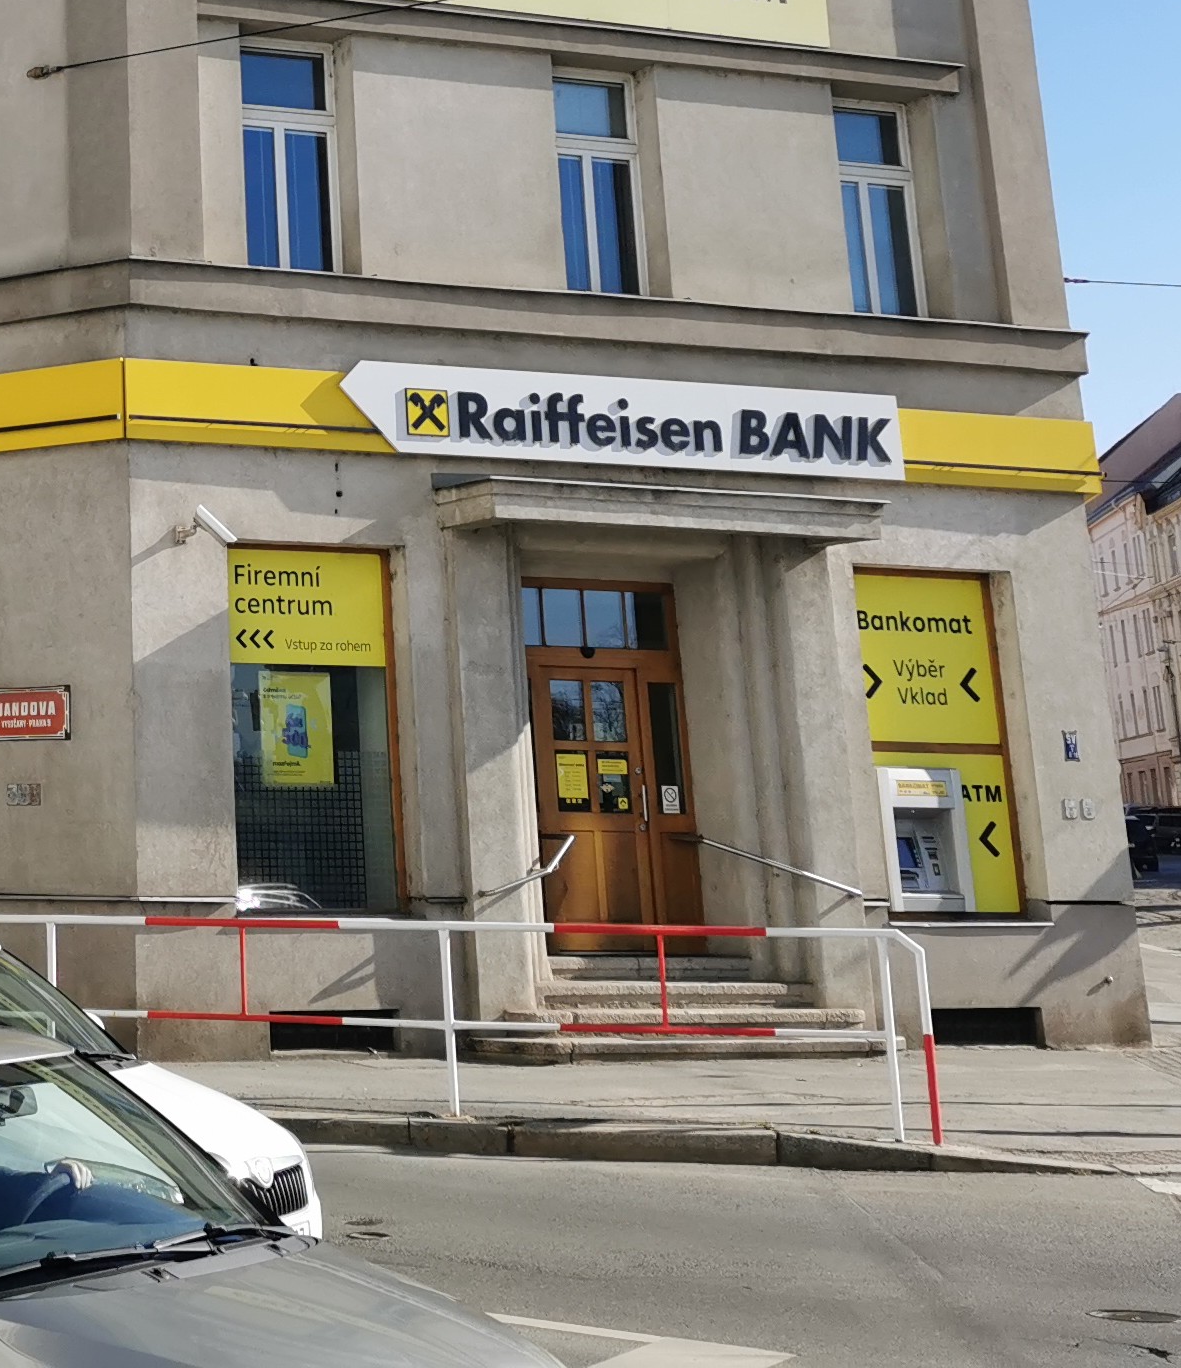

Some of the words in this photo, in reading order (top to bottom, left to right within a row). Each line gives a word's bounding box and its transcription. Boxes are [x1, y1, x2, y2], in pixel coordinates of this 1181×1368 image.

[458, 391, 723, 453] Raiffeisen
[738, 408, 895, 464] BANK
[234, 563, 321, 588] Firemní
[234, 595, 333, 616] centrum
[856, 609, 973, 635] Bankomat
[285, 638, 317, 653] Vstup
[320, 641, 333, 651] za
[335, 640, 372, 652] rohem
[892, 658, 946, 682] Výběr
[897, 686, 949, 706] Vklad
[961, 784, 1002, 803] ATM
